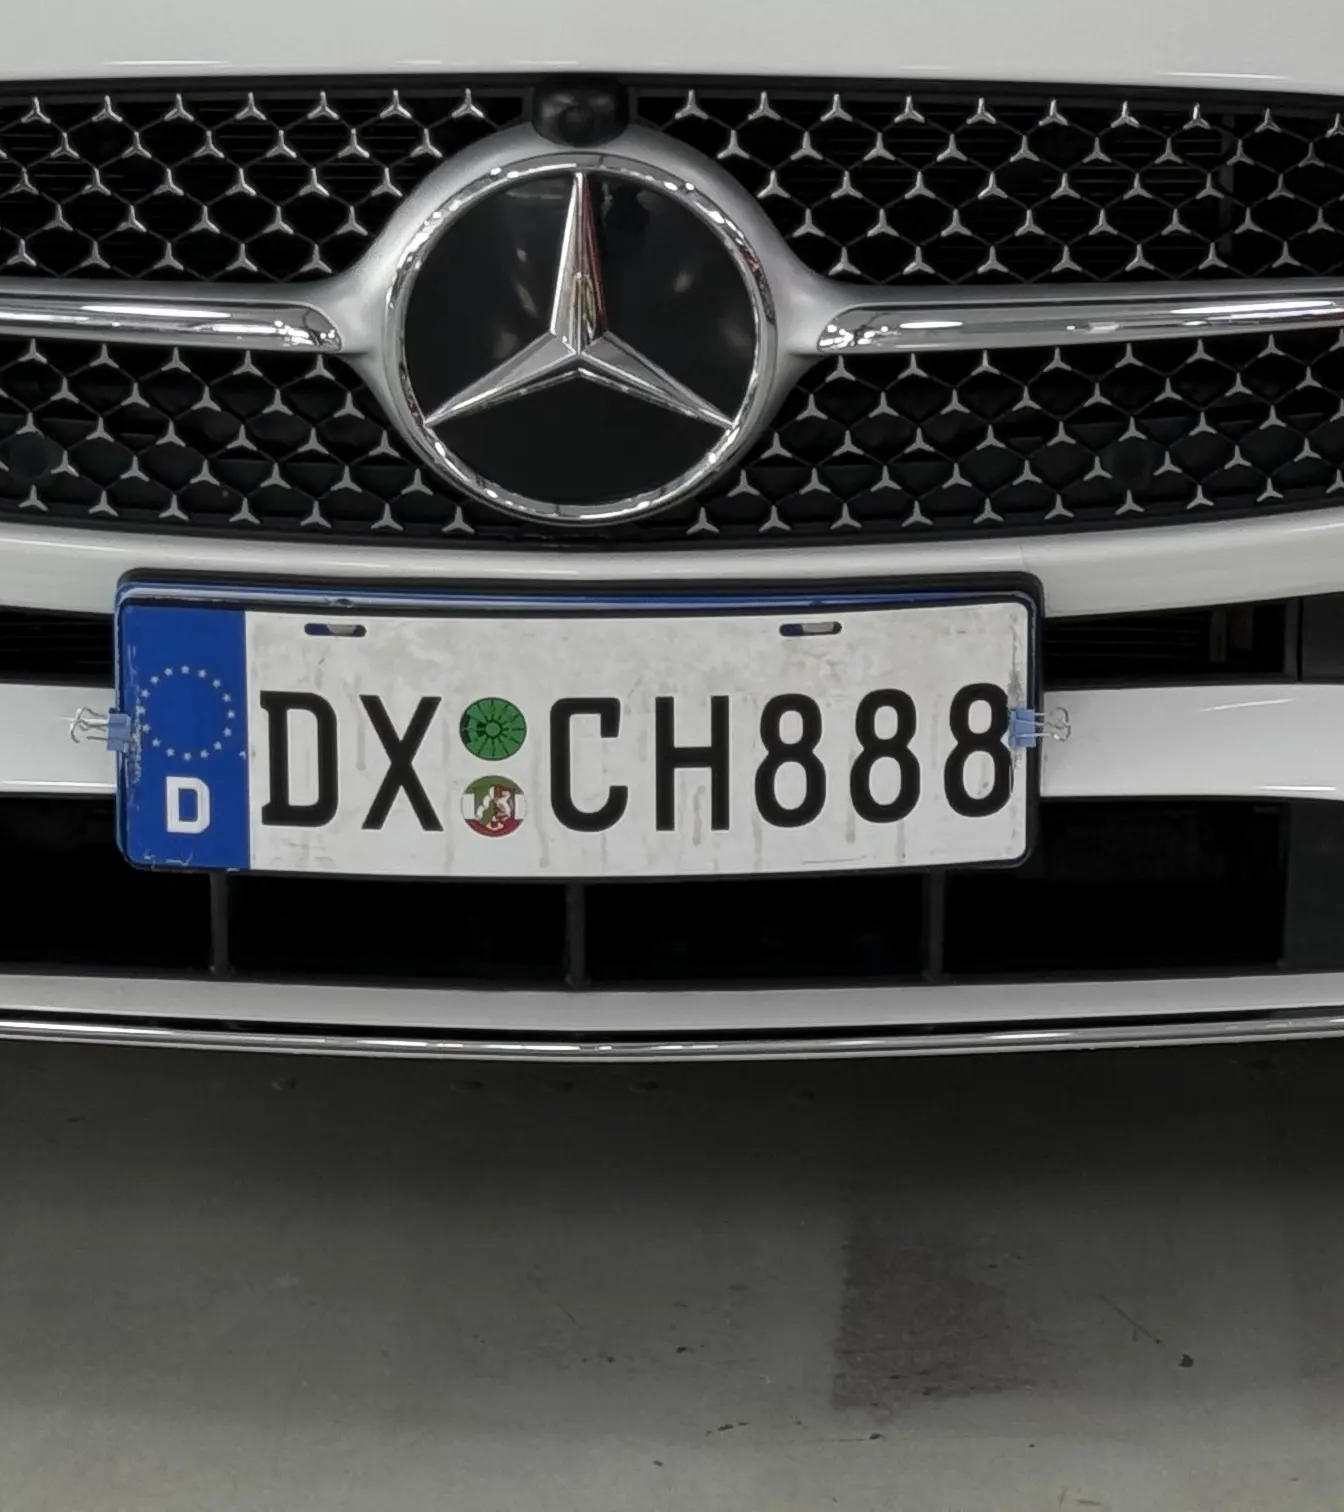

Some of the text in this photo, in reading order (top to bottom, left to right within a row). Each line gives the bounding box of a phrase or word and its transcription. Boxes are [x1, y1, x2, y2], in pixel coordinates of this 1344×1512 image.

[165, 775, 211, 834] D
[260, 682, 1014, 832] DX CH888
